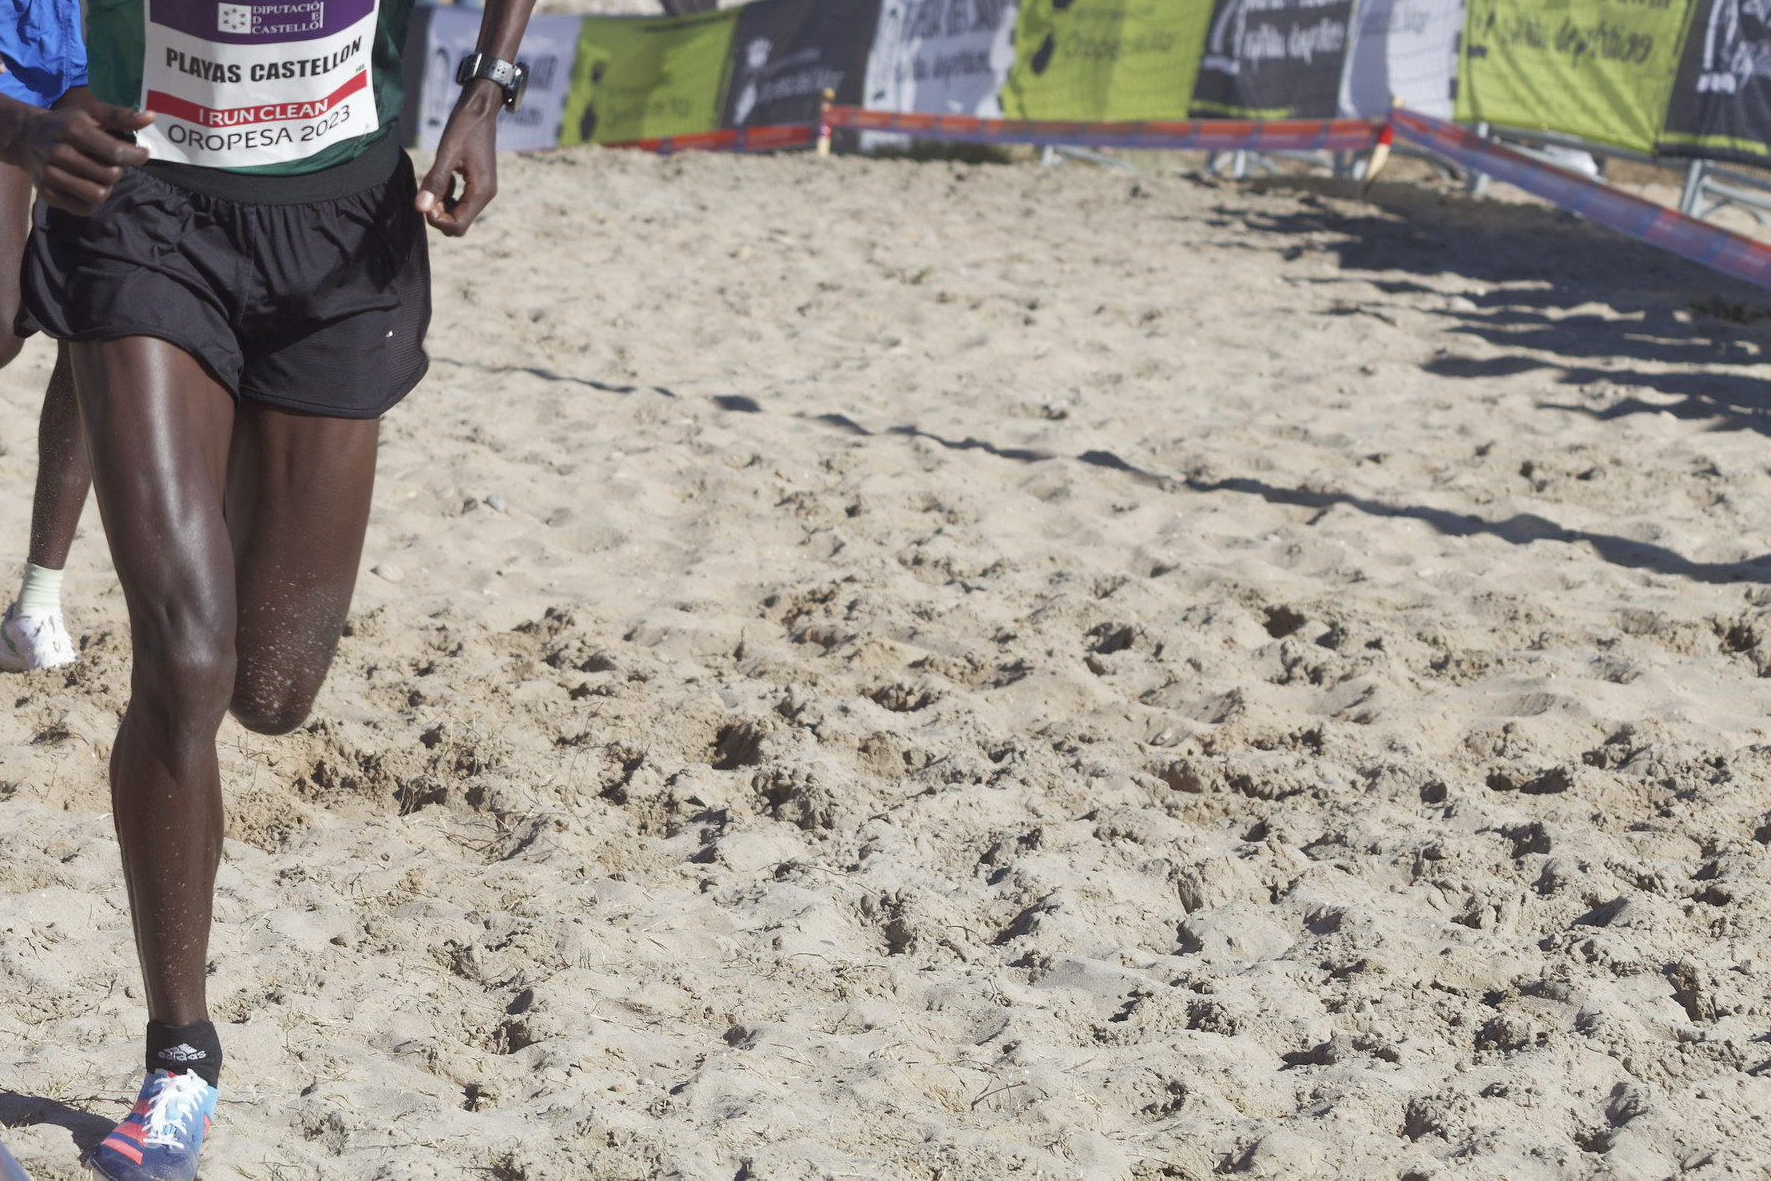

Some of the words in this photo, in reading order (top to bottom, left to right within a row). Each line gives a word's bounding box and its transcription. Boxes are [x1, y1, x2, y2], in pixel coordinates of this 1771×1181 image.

[252, 1, 320, 15] DIPUTACIÓ
[252, 16, 262, 24] D
[312, 12, 320, 21] E
[252, 21, 319, 34] CASTELLÓ
[166, 47, 242, 83] PLAYAS
[250, 35, 362, 83] CASTELLON
[209, 109, 255, 126] RUN
[259, 98, 329, 121] CLEAN
[167, 124, 292, 152] OROPESA
[300, 104, 351, 142] 2023
